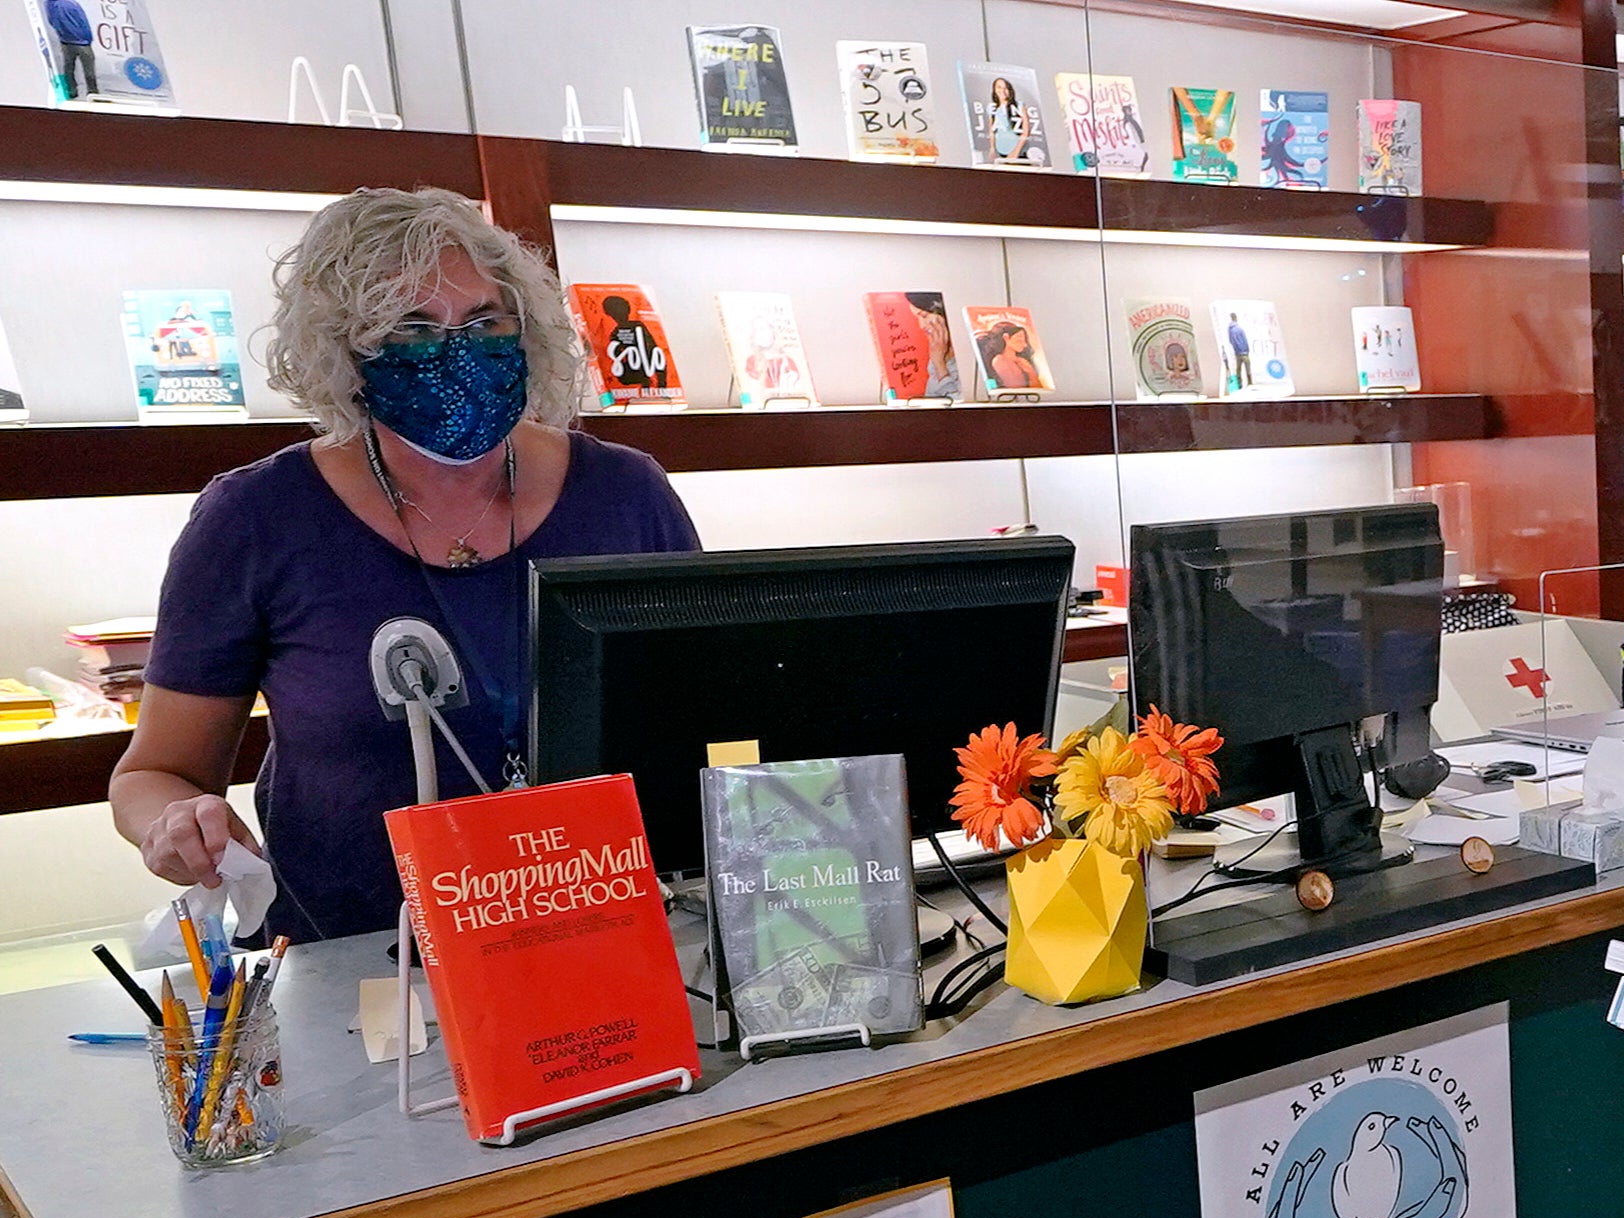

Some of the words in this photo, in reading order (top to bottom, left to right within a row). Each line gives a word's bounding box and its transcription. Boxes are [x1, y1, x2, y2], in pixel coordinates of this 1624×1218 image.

[101, 4, 118, 19] IS
[126, 10, 134, 25] A
[97, 23, 148, 54] GIFT
[854, 48, 912, 62] THE
[737, 69, 748, 90] I
[721, 96, 768, 118] LIVE
[973, 101, 1039, 118] BEING
[858, 108, 928, 133] BUS
[975, 114, 1043, 135] JAZZ
[1375, 119, 1398, 134] LIKE
[1072, 115, 1130, 152] Msfits
[1378, 131, 1405, 146] LOVE
[1381, 142, 1412, 158] STORY
[606, 326, 667, 378] solo
[153, 388, 233, 403] ADDRESS
[508, 826, 571, 857] THE
[717, 872, 756, 896] The
[763, 868, 806, 892] Last
[811, 863, 859, 887] Mall
[865, 860, 902, 883] Rat
[452, 897, 530, 934] HIGH
[532, 875, 648, 918] SCHOOL
[767, 901, 790, 912] Erik
[526, 1031, 575, 1053] ARTHUR
[589, 1019, 638, 1036] POWELL
[532, 1042, 588, 1065] ELEANOR
[592, 1030, 638, 1051] FARRAR
[542, 1065, 580, 1084] DAVID
[591, 1052, 635, 1071] COHEN
[1245, 1137, 1280, 1205] ALL
[1290, 1067, 1347, 1122] ARE
[1366, 1055, 1480, 1134] WELCOME
